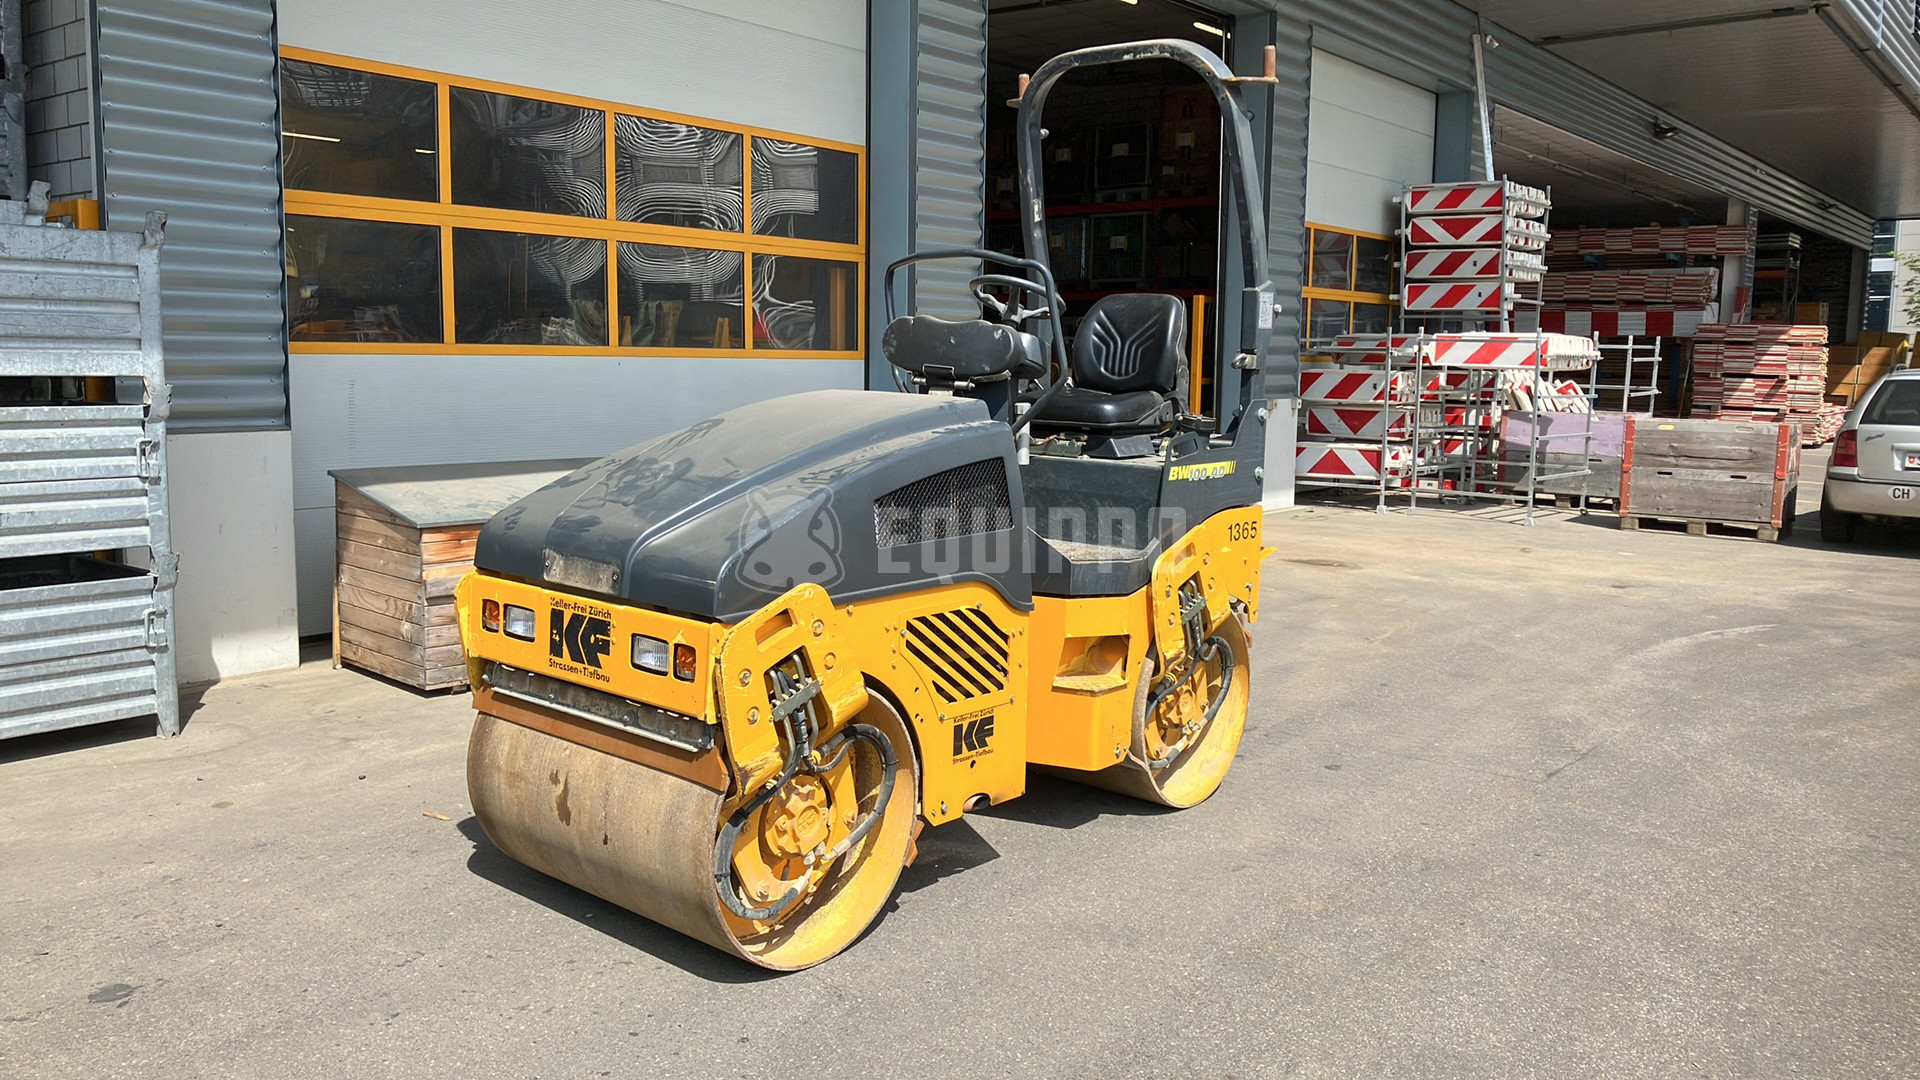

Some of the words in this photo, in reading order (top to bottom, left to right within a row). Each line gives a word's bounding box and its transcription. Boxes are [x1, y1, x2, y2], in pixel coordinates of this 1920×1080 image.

[1892, 487, 1910, 499] CH
[1228, 521, 1257, 542] 1365
[588, 605, 612, 619] Zürich
[549, 608, 611, 669] KF
[953, 714, 994, 757] KF
